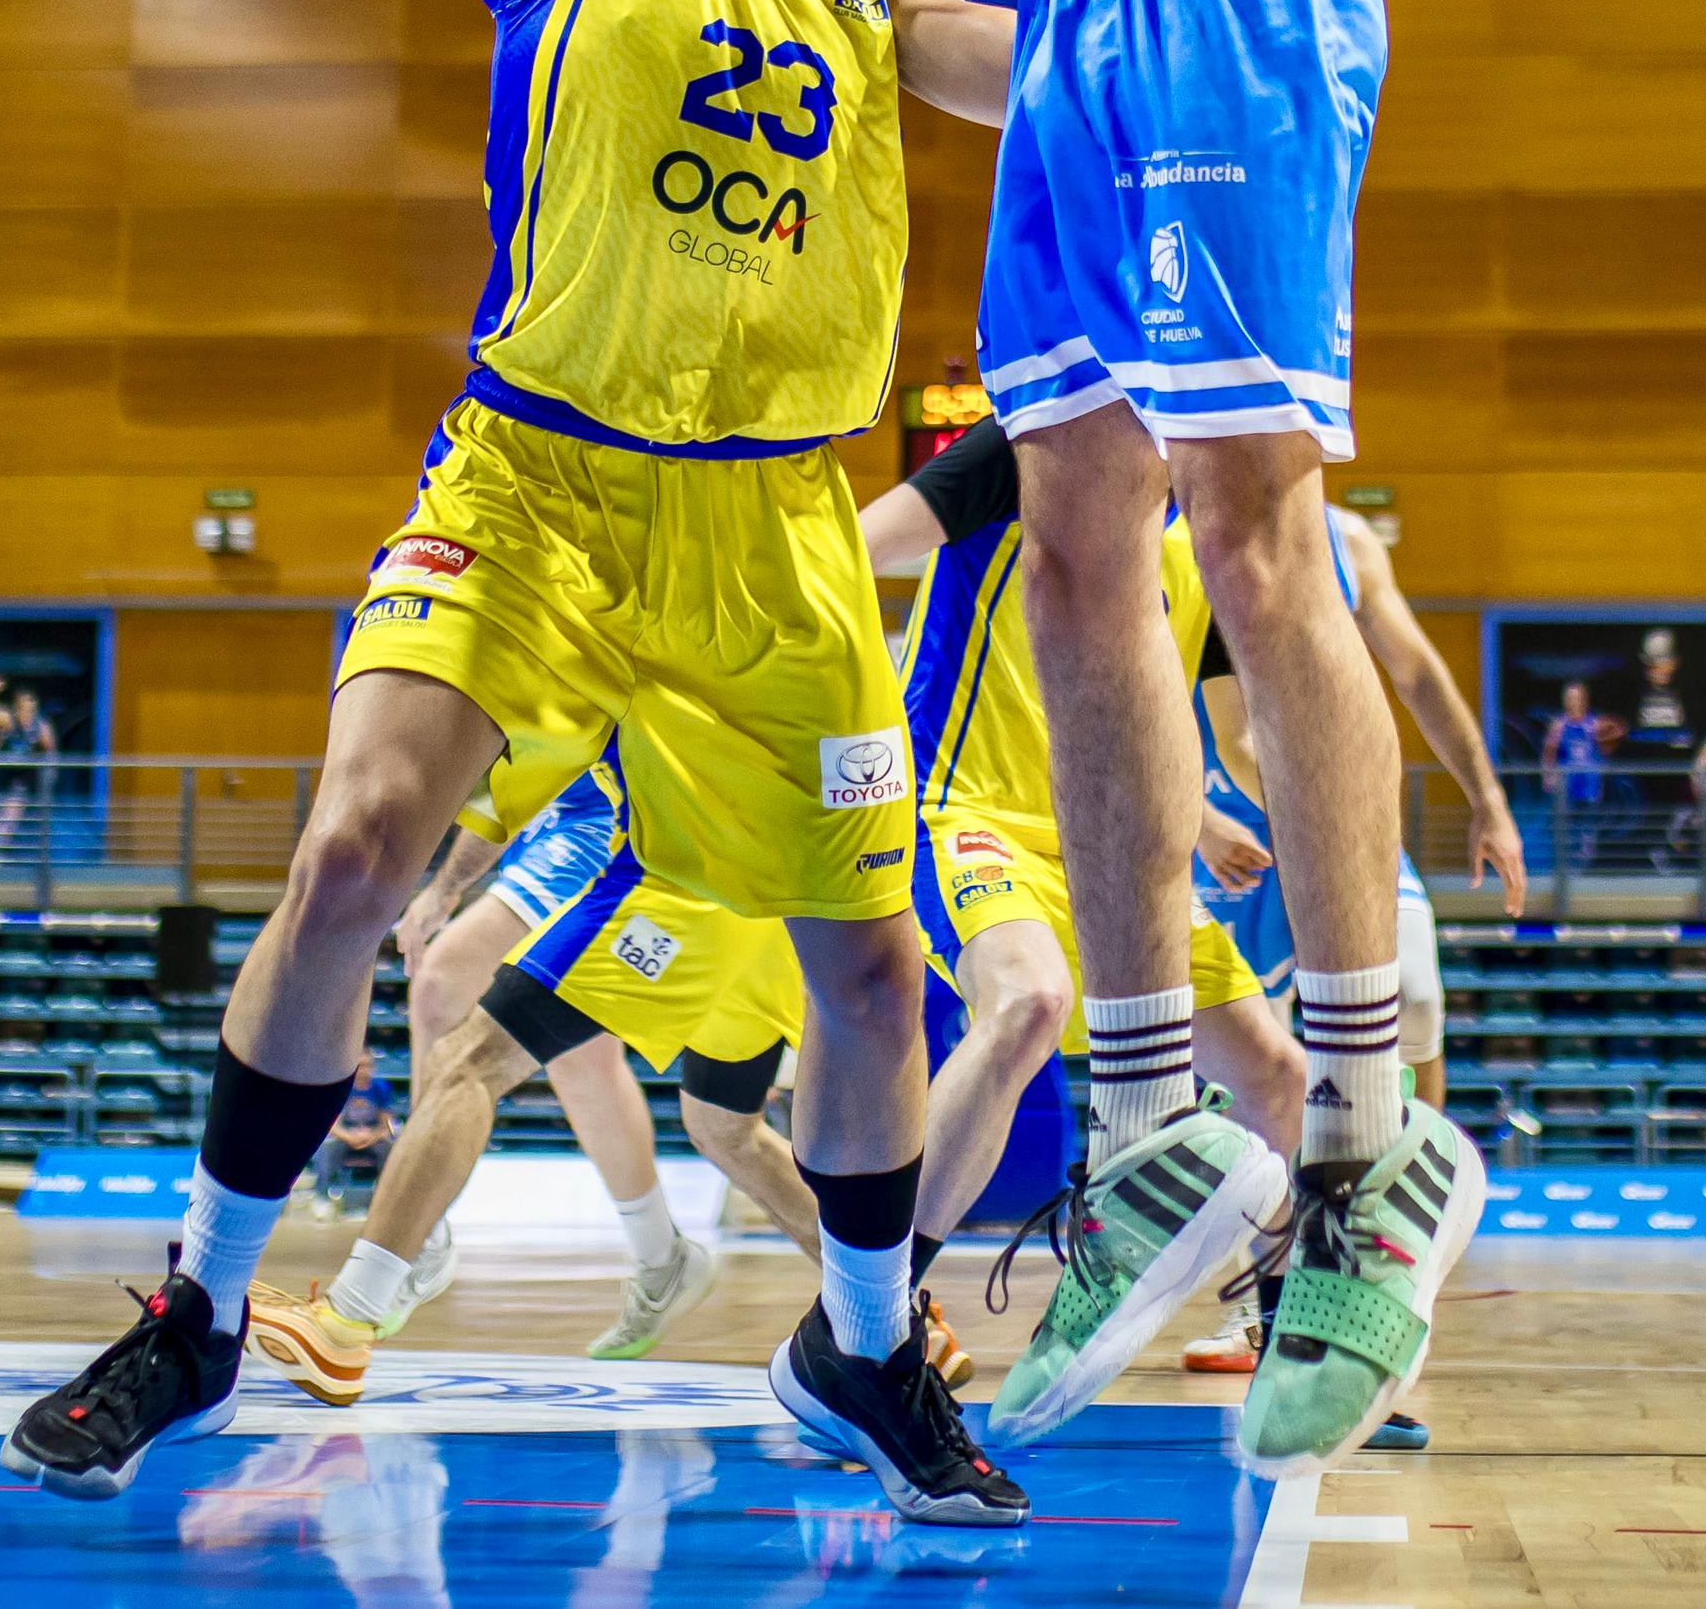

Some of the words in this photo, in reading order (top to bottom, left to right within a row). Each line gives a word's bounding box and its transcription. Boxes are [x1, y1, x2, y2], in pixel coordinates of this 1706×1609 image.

[679, 18, 838, 162] 23
[652, 150, 822, 255] OCA
[668, 229, 773, 285] GLOBAL
[1141, 309, 1185, 325] CIUDAD
[1160, 326, 1203, 343] HUELVA
[363, 600, 422, 627] SALOU
[829, 781, 903, 804] TOYOTA
[618, 935, 661, 977] tac
